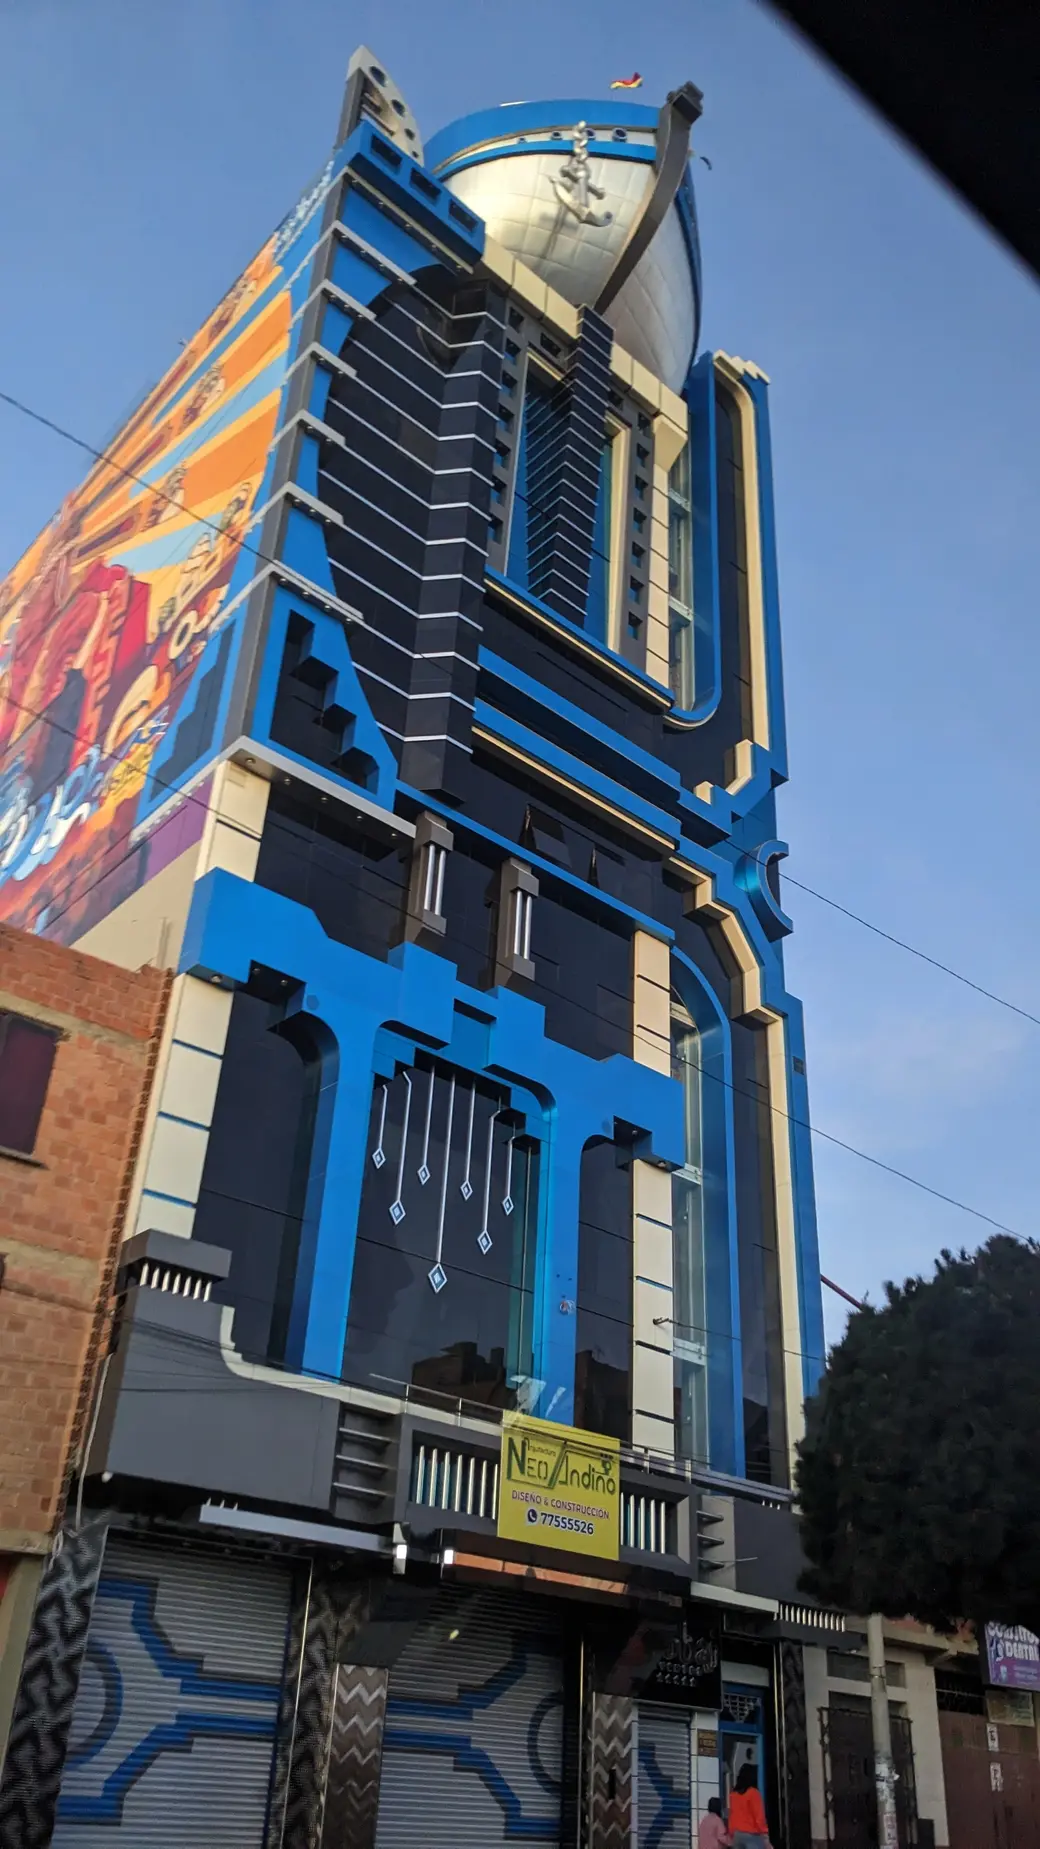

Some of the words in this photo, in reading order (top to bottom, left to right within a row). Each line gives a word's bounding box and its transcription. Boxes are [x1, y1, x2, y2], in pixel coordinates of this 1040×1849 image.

[548, 1442, 616, 1495] Andino
[543, 1497, 549, 1506] &
[540, 1512, 594, 1535] 77555526
